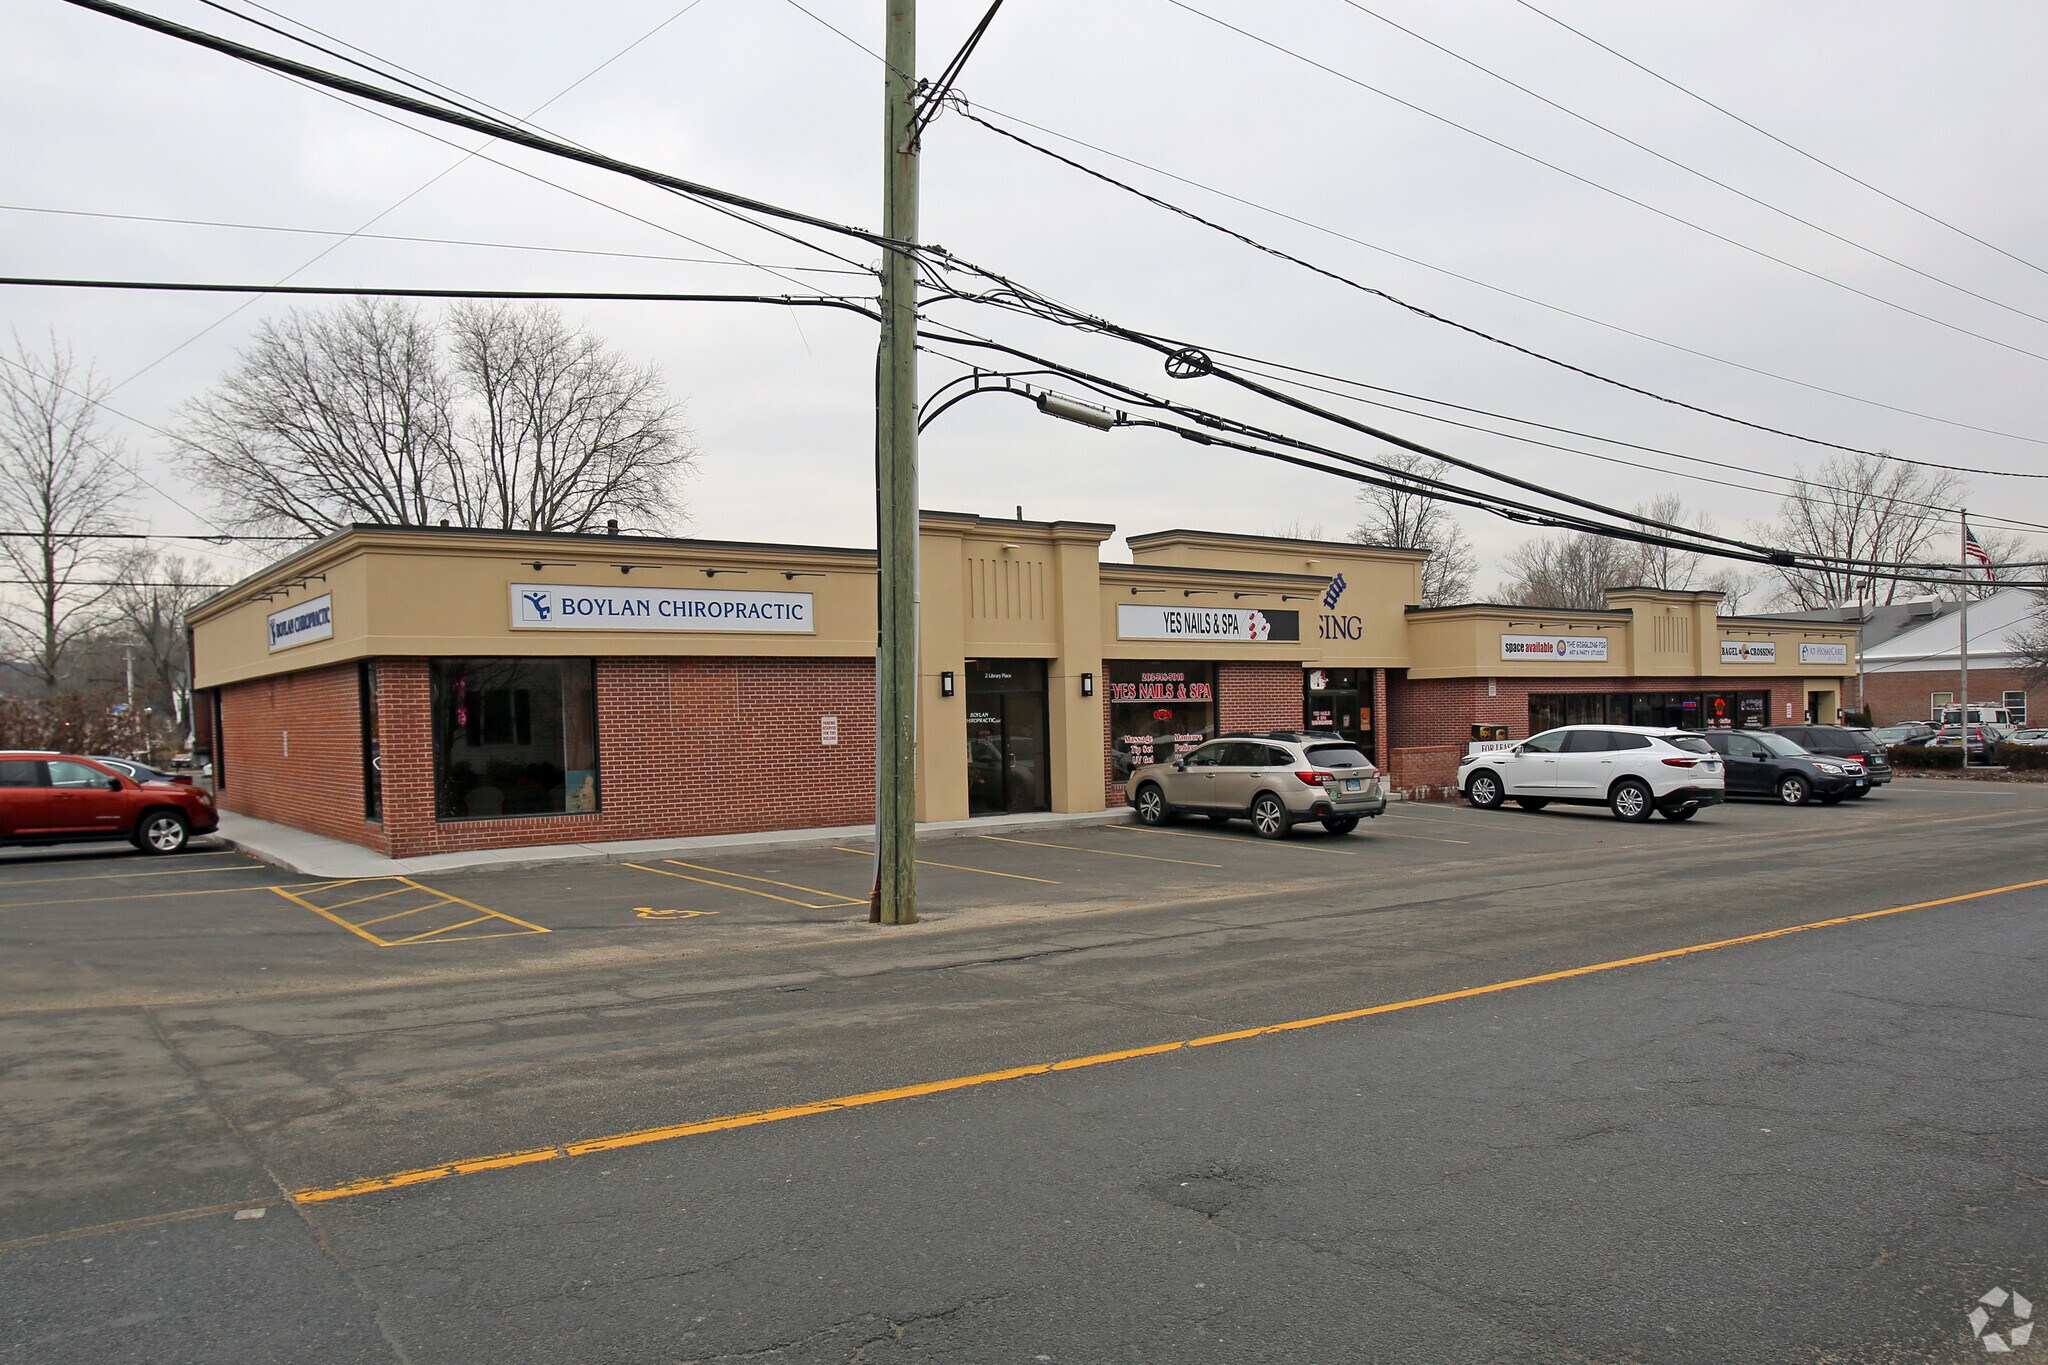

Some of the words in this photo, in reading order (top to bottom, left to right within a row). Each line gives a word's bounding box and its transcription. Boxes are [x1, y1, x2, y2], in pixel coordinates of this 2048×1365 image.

[561, 598, 650, 617] BOYLAN
[658, 600, 804, 620] CHIROPRACTIC
[1163, 611, 1182, 633] YES
[1184, 612, 1211, 634] NAILS
[1213, 613, 1220, 634] &
[1221, 613, 1240, 635] SPA
[1505, 642, 1525, 653] space
[1525, 642, 1554, 653] available
[1721, 647, 1739, 656] BAGEL
[1750, 648, 1775, 656] CROSSING
[1111, 683, 1136, 699] YES
[1139, 683, 1174, 699] NAILS
[1177, 683, 1187, 699] &
[1189, 683, 1212, 699] SPA
[1153, 709, 1173, 719] OPEN
[1125, 735, 1153, 744] Massage
[1174, 733, 1203, 742] Manicure
[1481, 744, 1494, 752] FOR
